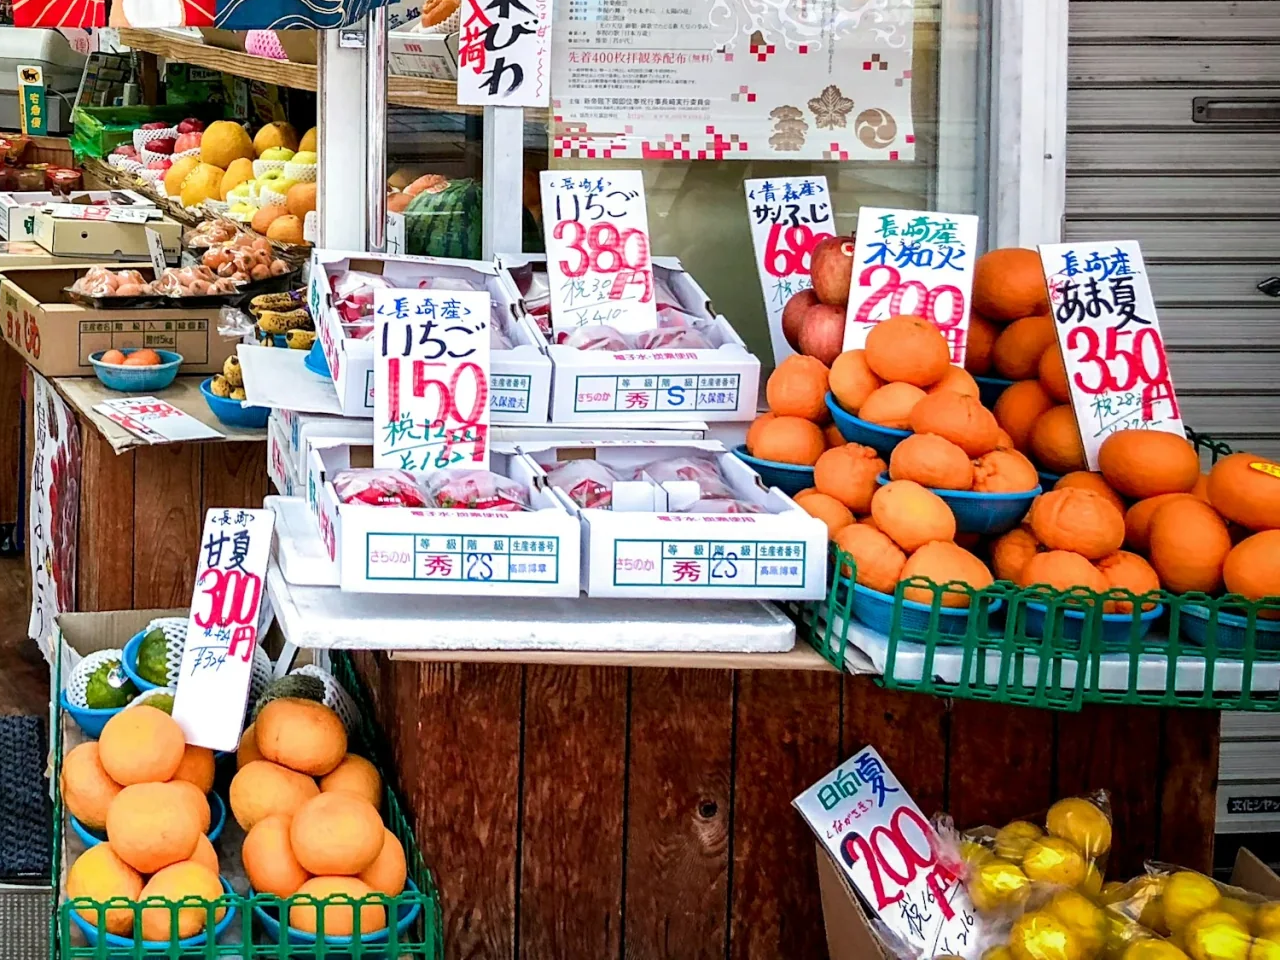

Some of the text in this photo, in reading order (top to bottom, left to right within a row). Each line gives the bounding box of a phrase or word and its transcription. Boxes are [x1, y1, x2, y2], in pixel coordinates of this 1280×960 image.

[556, 190, 639, 222] いちご
[875, 214, 960, 245] 長崎産
[553, 219, 654, 303] 380 円
[863, 242, 967, 271] 不知火
[1059, 247, 1140, 281] 長崎産
[853, 264, 965, 328] 200
[1056, 276, 1152, 330] あま夏
[382, 320, 486, 359] いちご
[1067, 326, 1180, 421] 350 円
[388, 357, 488, 428] 150
[625, 391, 650, 409] 秀
[667, 385, 685, 406] S
[204, 530, 252, 576] 甘夏
[420, 539, 457, 550] 等級
[467, 539, 504, 551] 階級
[513, 541, 554, 552] 生産者番号
[668, 545, 704, 555] 等級
[759, 546, 801, 557] 生産者番号
[424, 555, 452, 576] 秀
[466, 553, 493, 581] 2S
[673, 561, 701, 582] 秀
[711, 551, 738, 578] 2S
[194, 568, 261, 662] 300 円
[817, 753, 899, 810] 日向夏
[840, 806, 938, 911] 200
